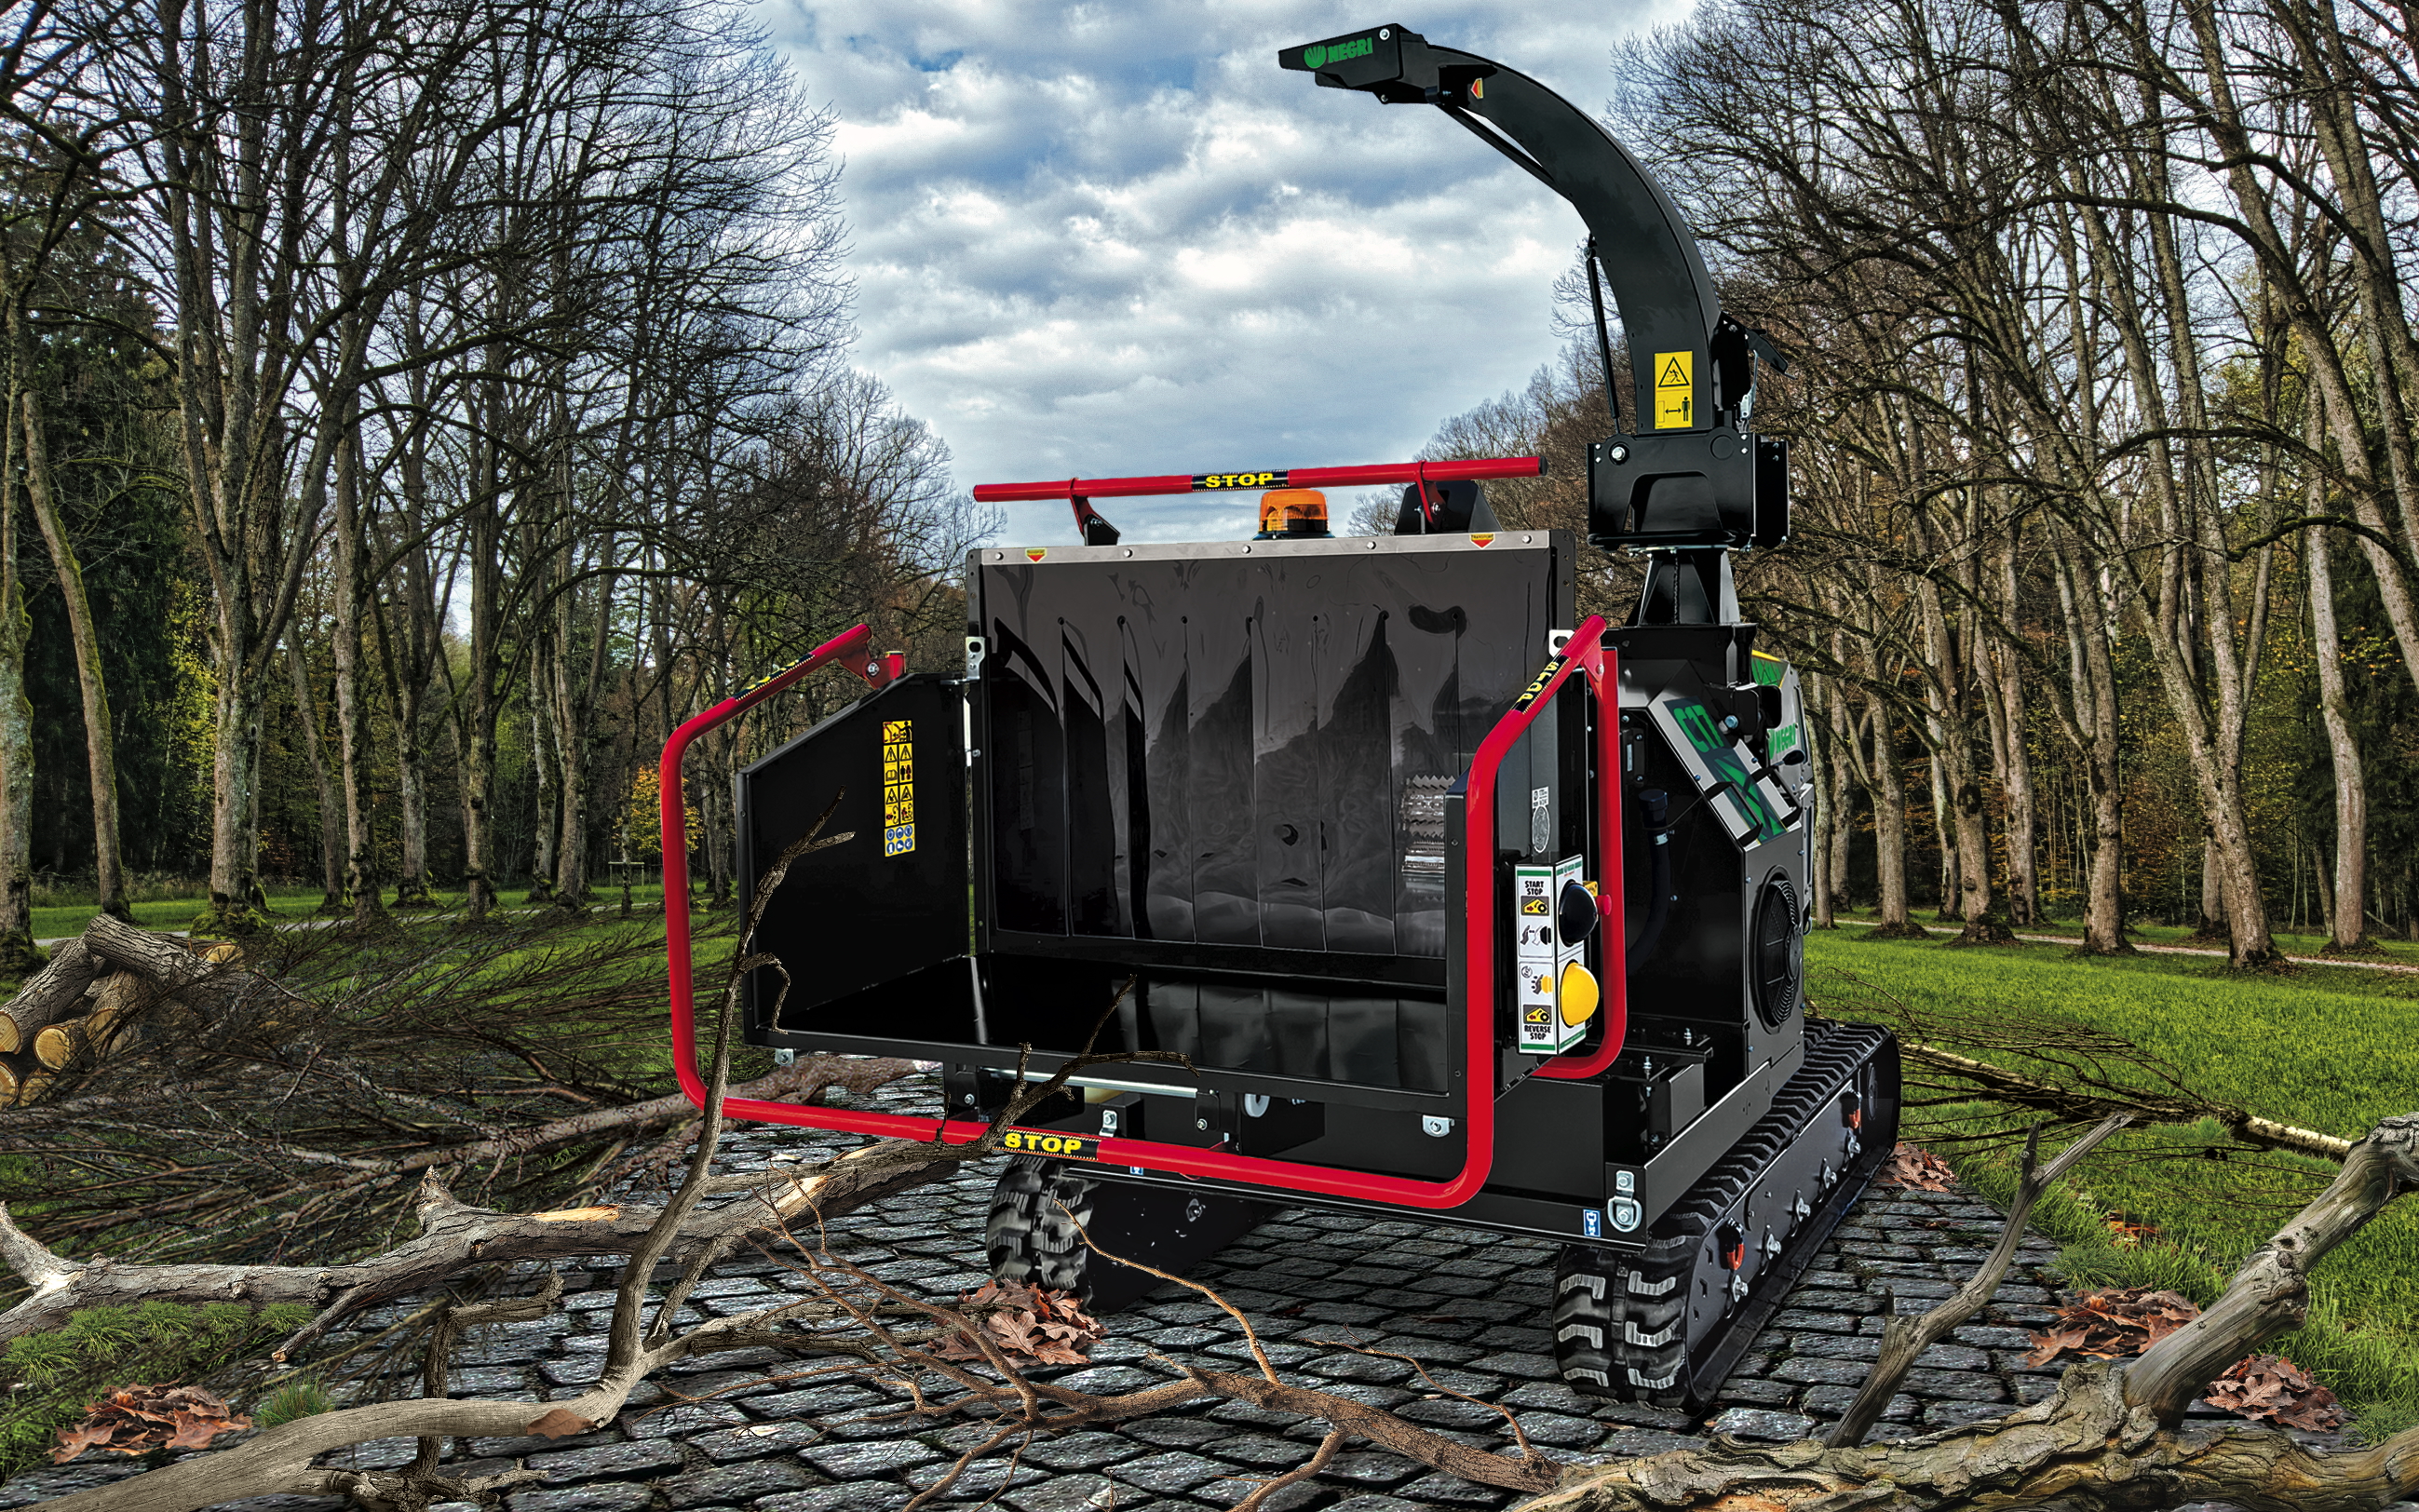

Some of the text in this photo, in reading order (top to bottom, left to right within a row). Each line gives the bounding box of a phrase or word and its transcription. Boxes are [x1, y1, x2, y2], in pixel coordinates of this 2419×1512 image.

[1328, 37, 1373, 63] NEGRI
[1206, 473, 1274, 488] STOP
[1776, 722, 1796, 754] NEGRI
[1524, 880, 1544, 888] START
[1526, 887, 1543, 896] STOP
[1523, 1024, 1551, 1033] REVERSE
[1005, 1132, 1082, 1154] STOP
